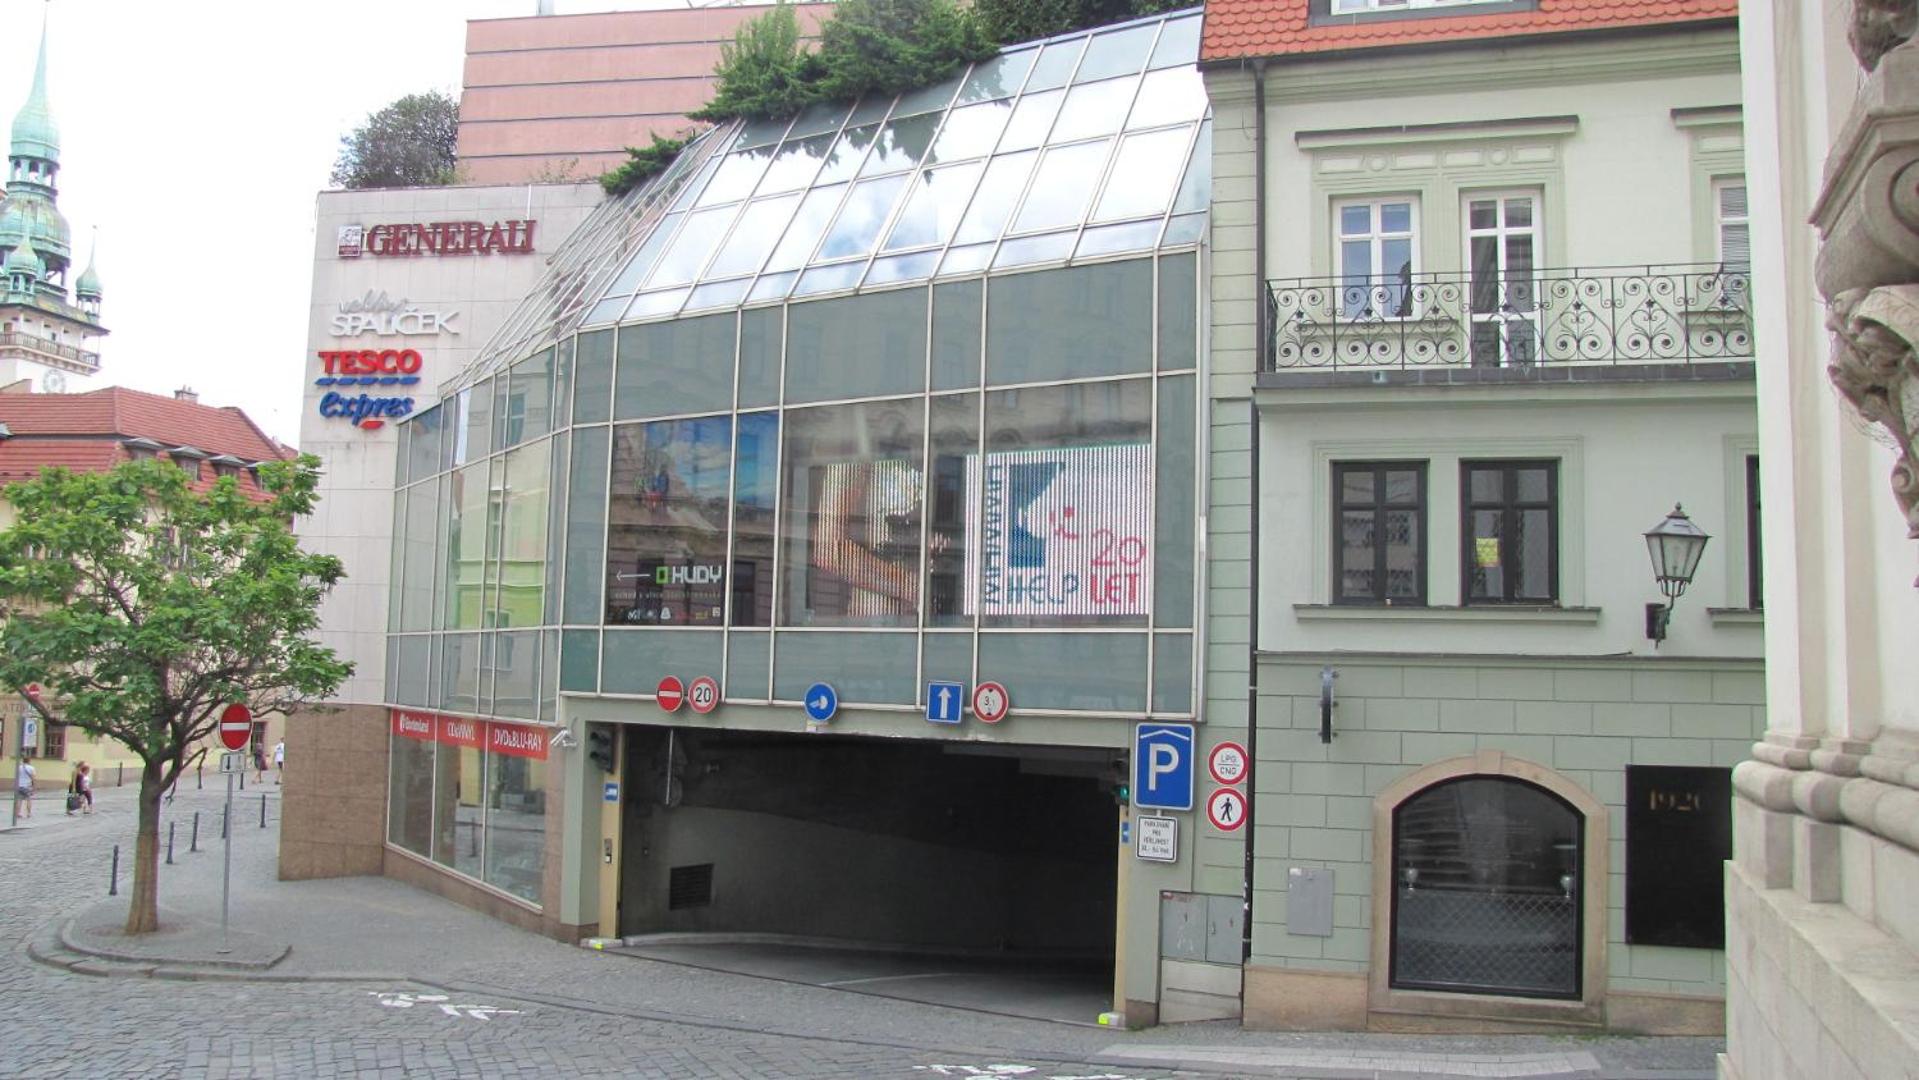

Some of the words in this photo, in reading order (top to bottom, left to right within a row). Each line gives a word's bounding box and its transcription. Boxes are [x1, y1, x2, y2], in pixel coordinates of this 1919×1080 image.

[367, 219, 537, 257] GENERALI
[318, 349, 423, 376] TESCO
[1091, 528, 1147, 567] 20
[672, 565, 722, 584] HUDY
[1008, 571, 1080, 604] HELP
[1090, 572, 1140, 604] LET
[695, 686, 711, 703] 20
[1148, 743, 1179, 791] P
